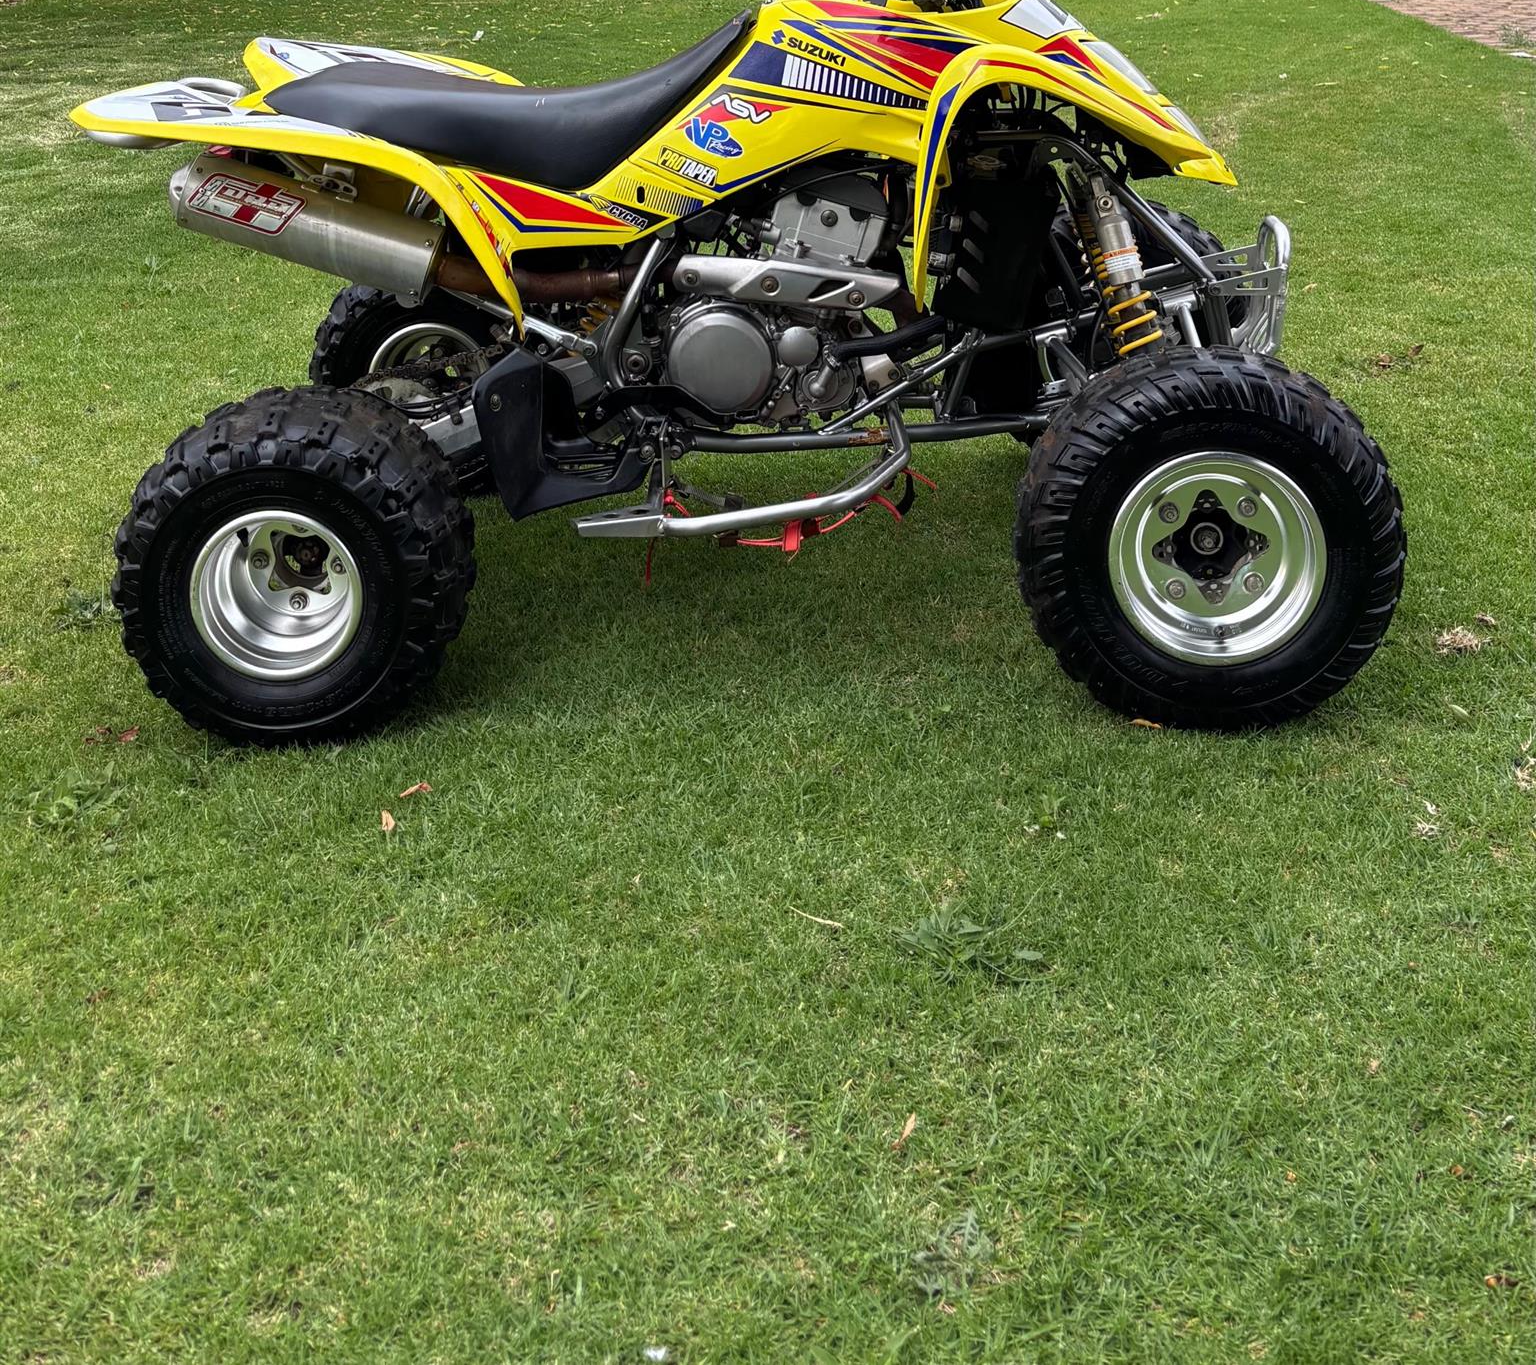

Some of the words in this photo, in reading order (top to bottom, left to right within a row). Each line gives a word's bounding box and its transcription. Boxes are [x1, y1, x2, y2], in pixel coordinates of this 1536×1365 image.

[786, 36, 847, 67] SUZUKI
[710, 92, 772, 124] ASV
[690, 116, 730, 151] VP
[708, 140, 743, 155] Racing
[607, 204, 649, 230] CYCRA
